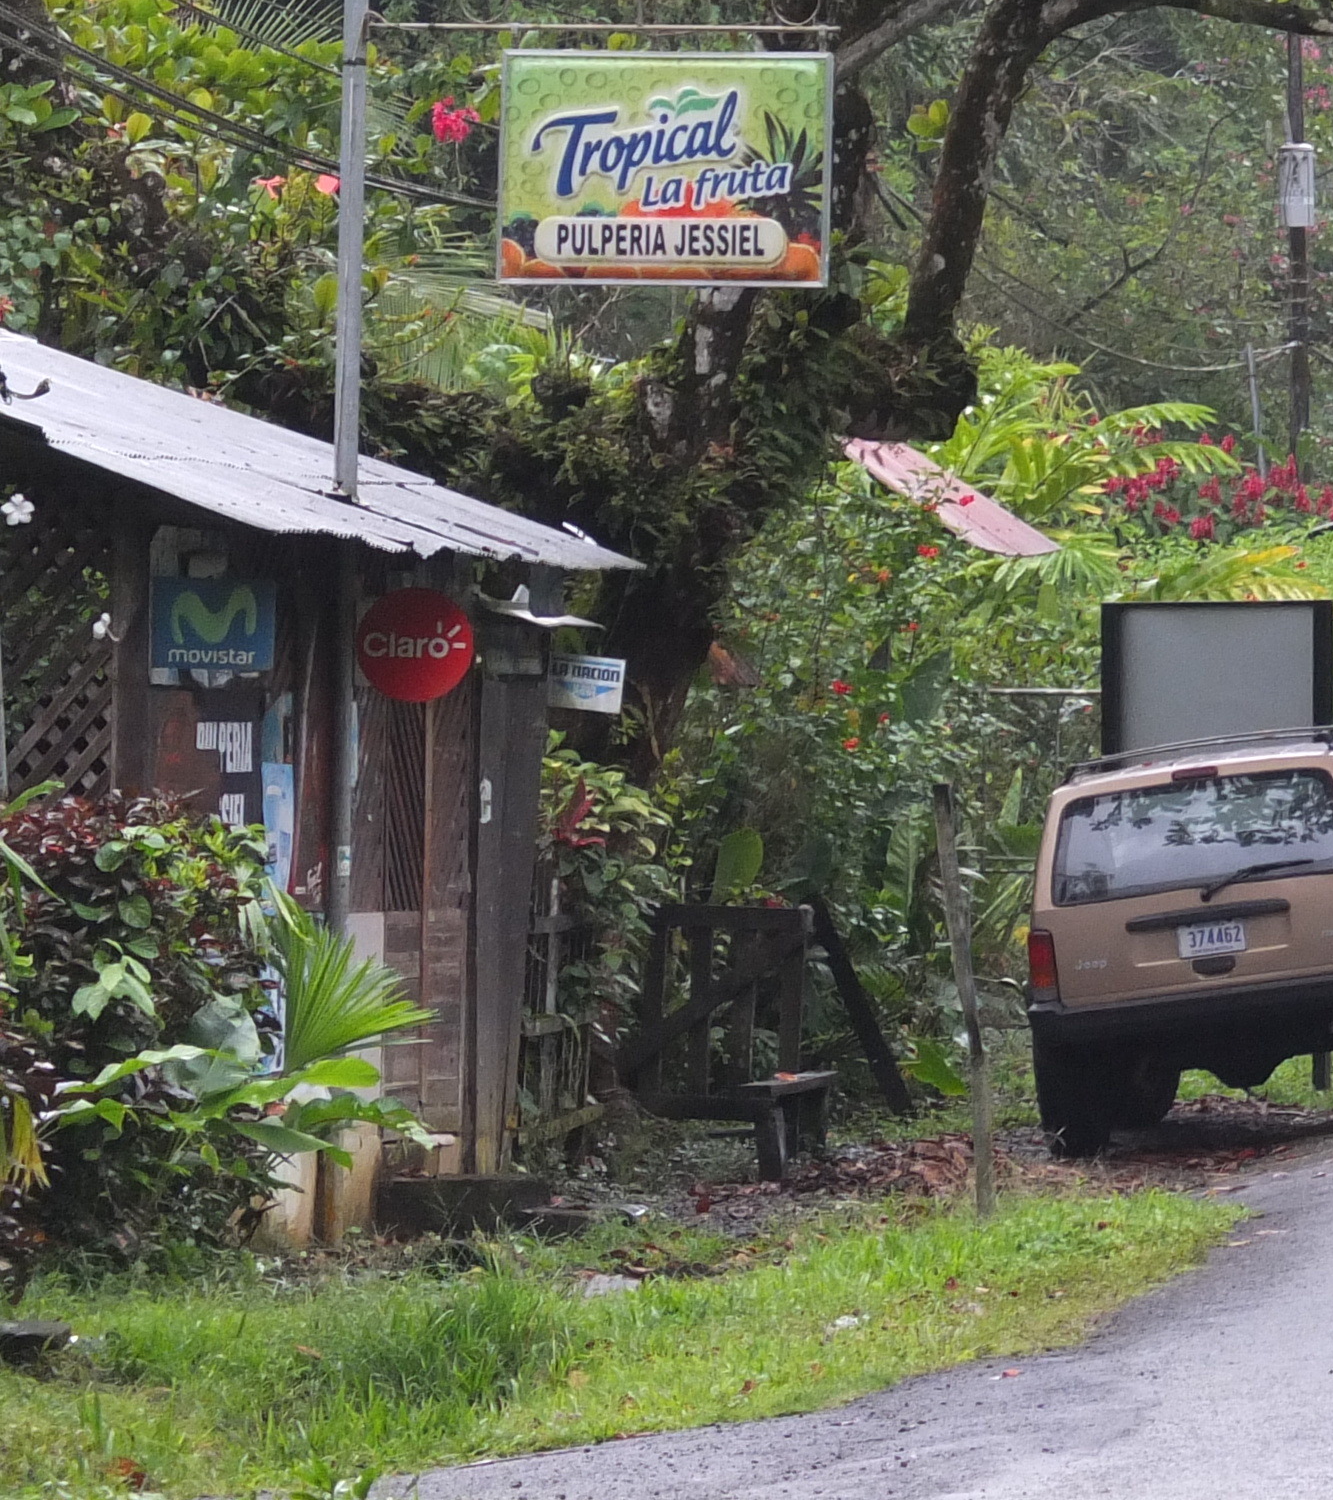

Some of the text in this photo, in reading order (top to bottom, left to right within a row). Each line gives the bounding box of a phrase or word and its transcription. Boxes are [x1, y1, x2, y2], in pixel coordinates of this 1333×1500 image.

[531, 90, 738, 197] Tropical
[694, 164, 788, 206] fruta
[556, 223, 765, 257] PULPERIA JESSIEL
[167, 648, 256, 665] movistar
[363, 632, 449, 659] Claro
[1187, 925, 1242, 948] 374462
